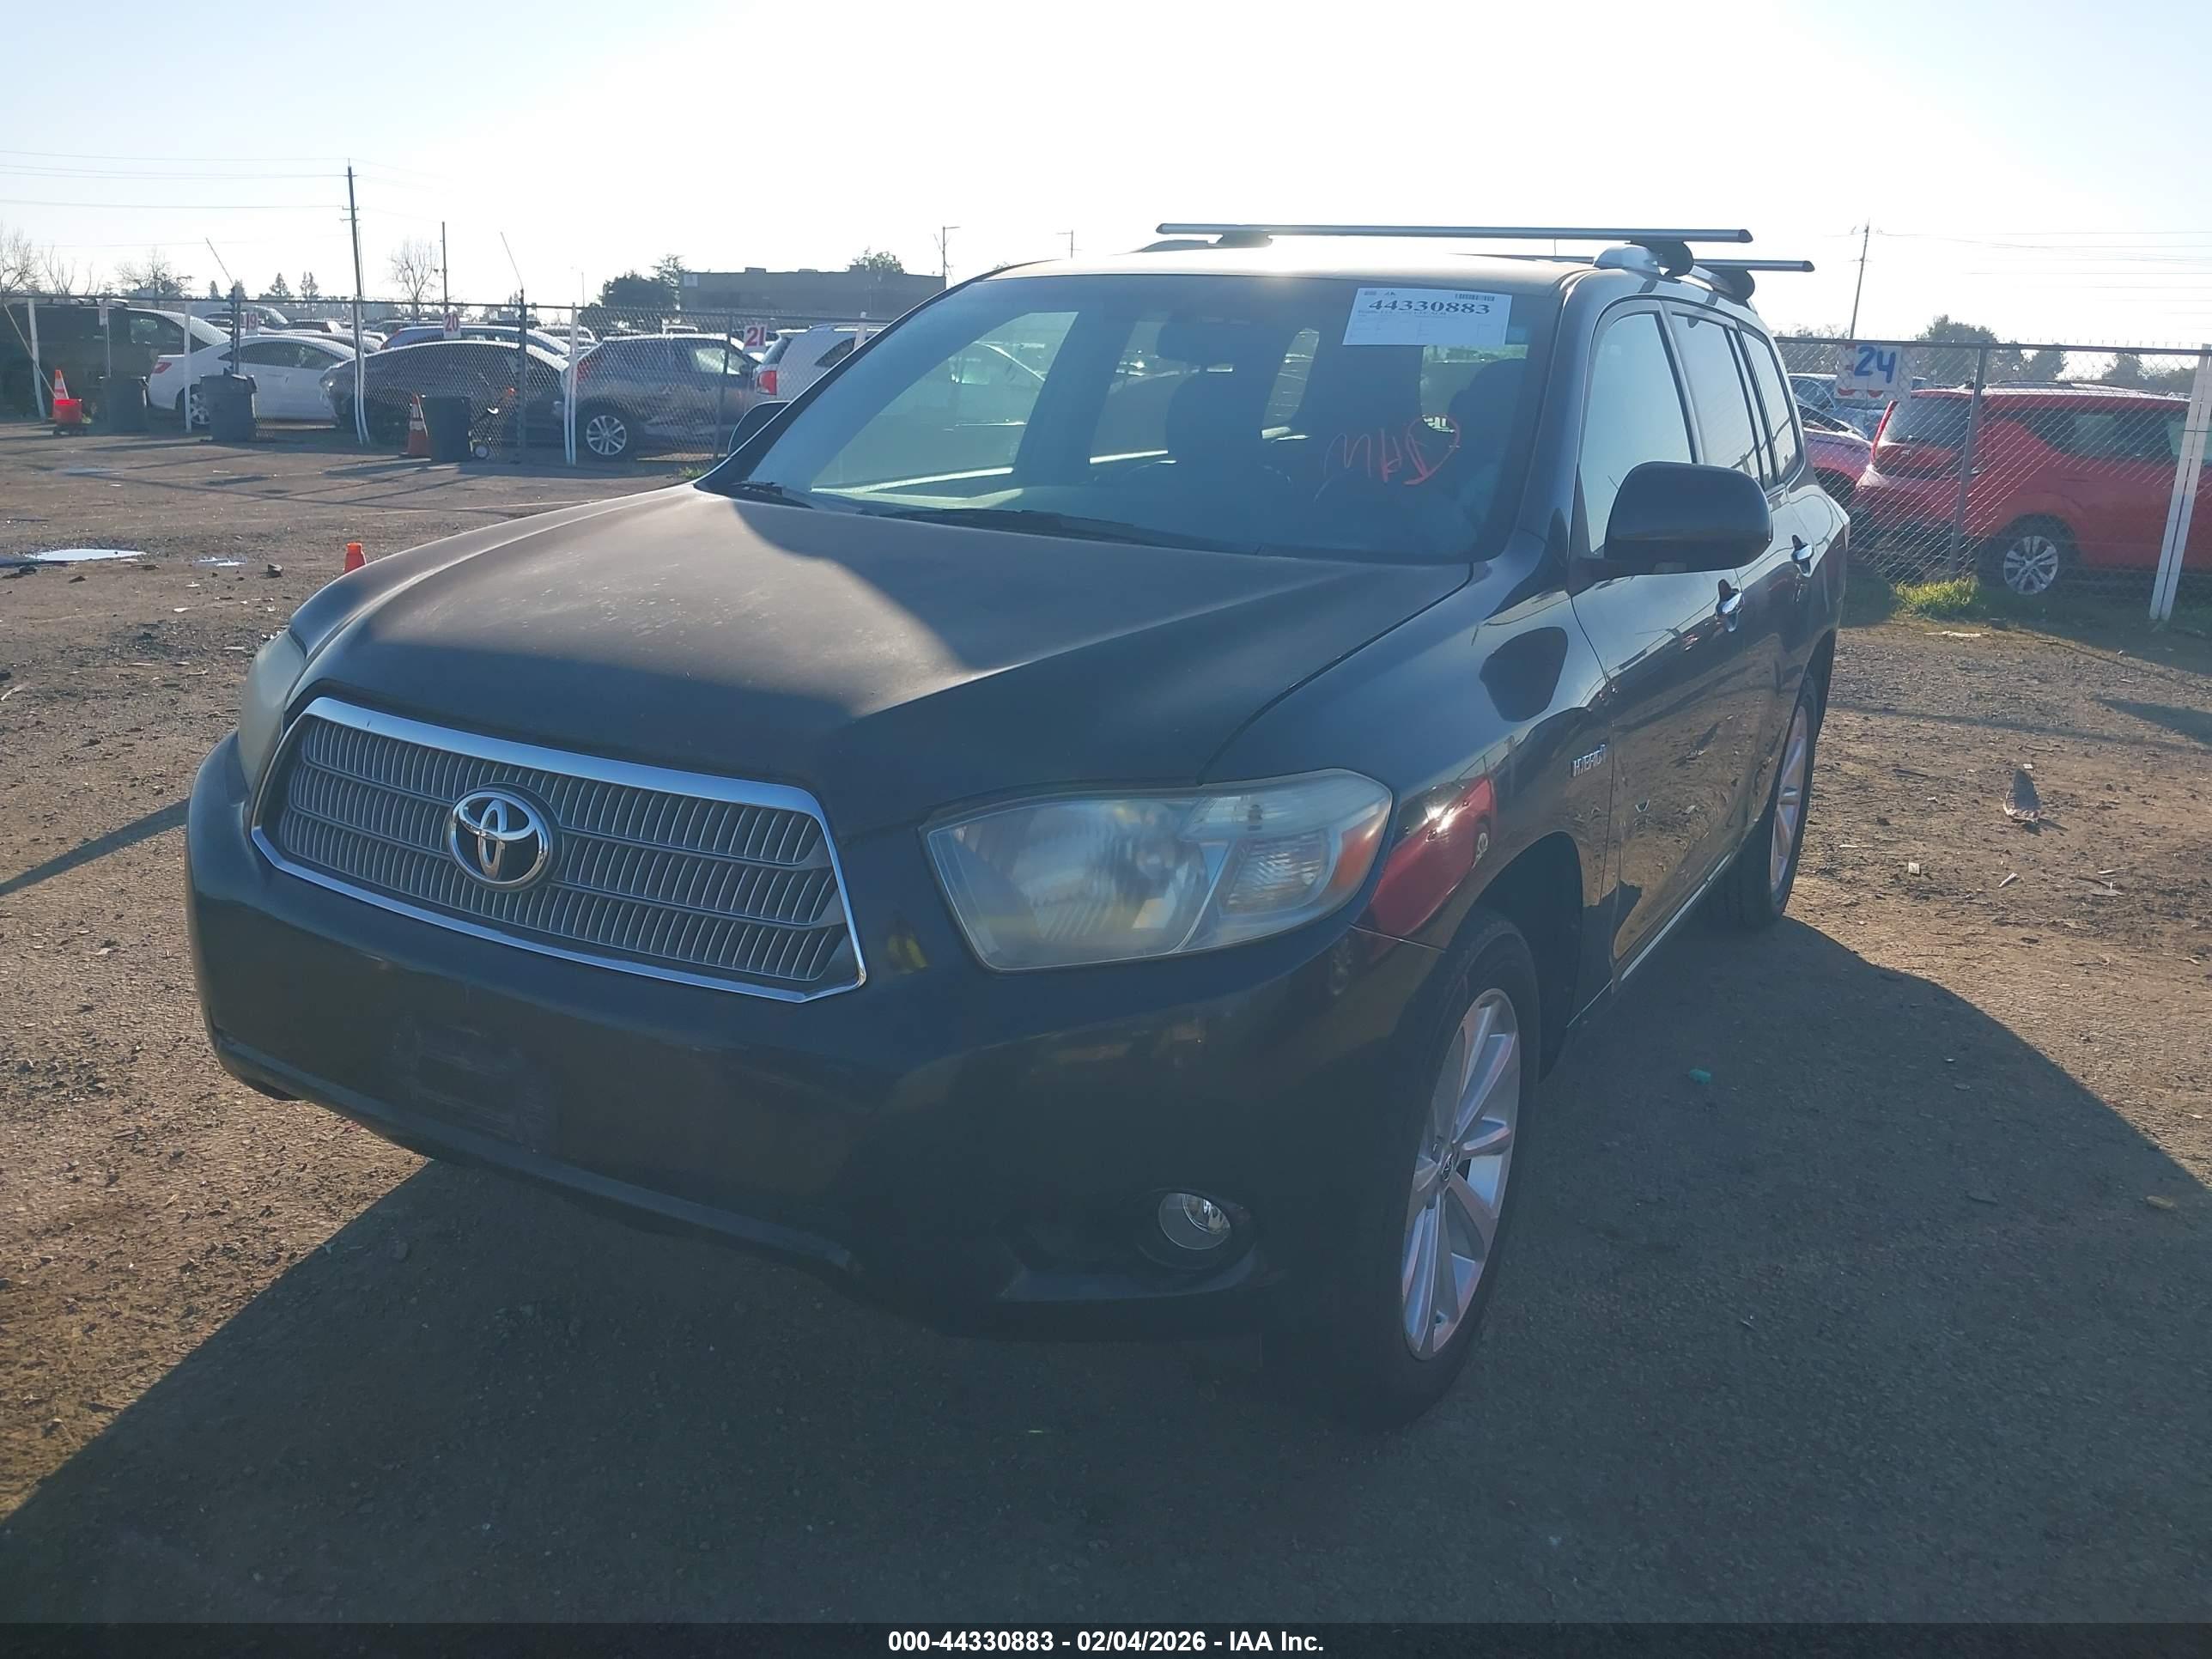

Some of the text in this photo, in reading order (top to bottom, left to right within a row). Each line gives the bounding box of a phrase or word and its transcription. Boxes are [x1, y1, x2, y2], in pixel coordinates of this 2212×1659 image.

[1368, 300, 1491, 315] 44330883
[444, 313, 459, 332] 20
[744, 326, 765, 347] 21
[1854, 345, 1897, 385] 24
